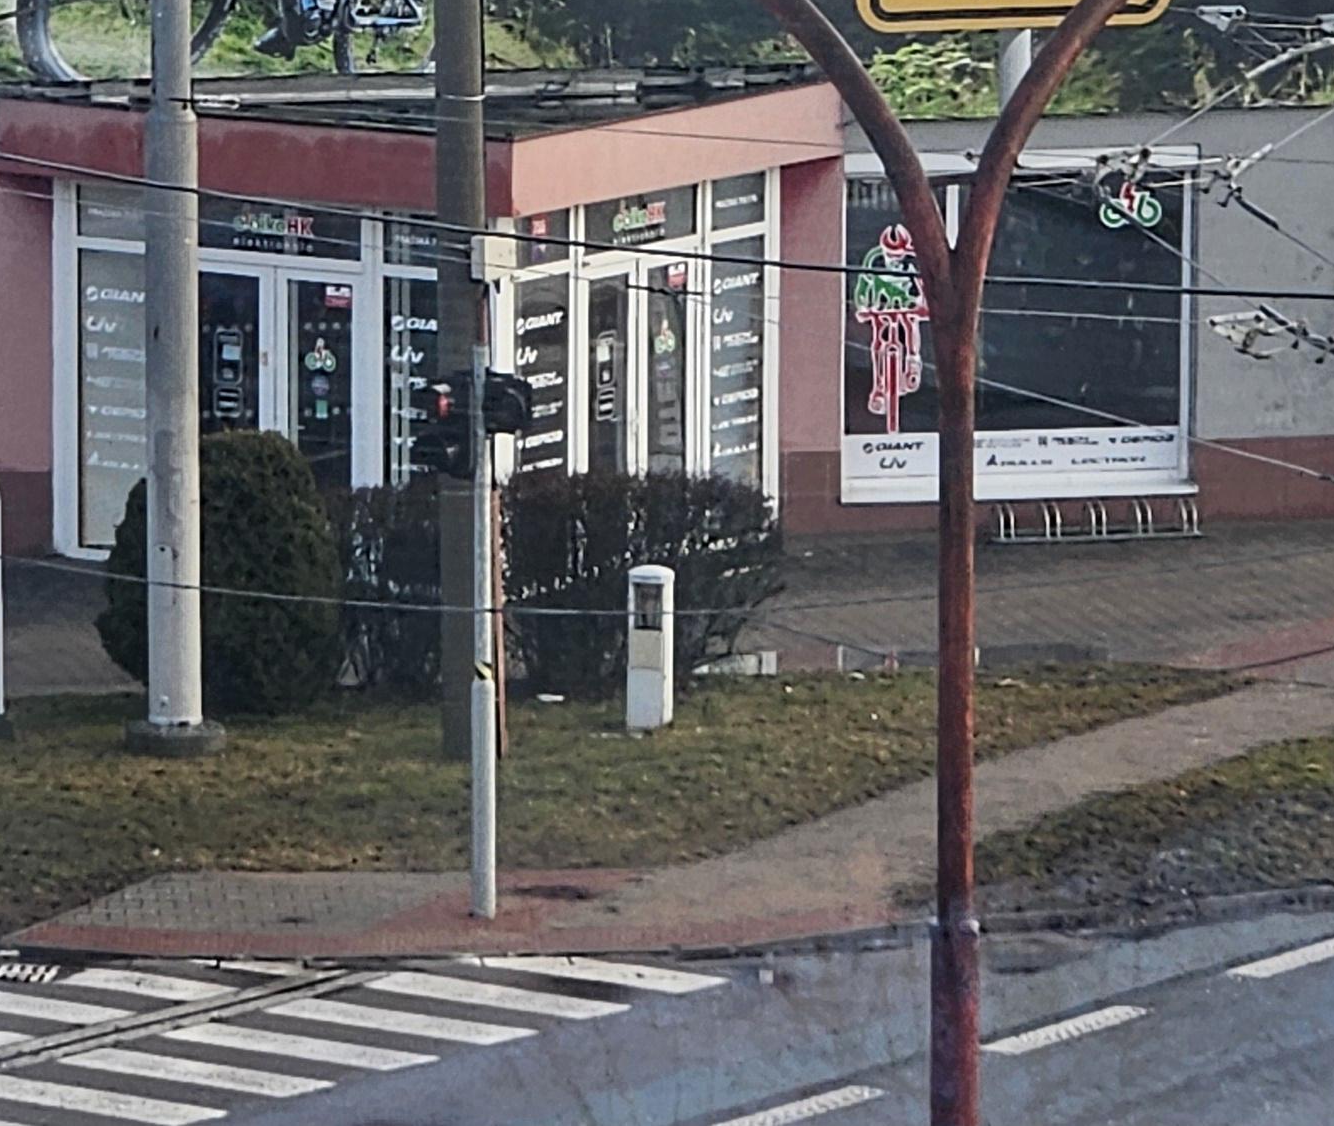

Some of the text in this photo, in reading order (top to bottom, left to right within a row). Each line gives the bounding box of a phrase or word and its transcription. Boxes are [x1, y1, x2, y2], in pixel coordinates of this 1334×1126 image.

[100, 288, 146, 303] GIAN
[525, 311, 564, 330] GIANT
[875, 441, 925, 452] GIANT
